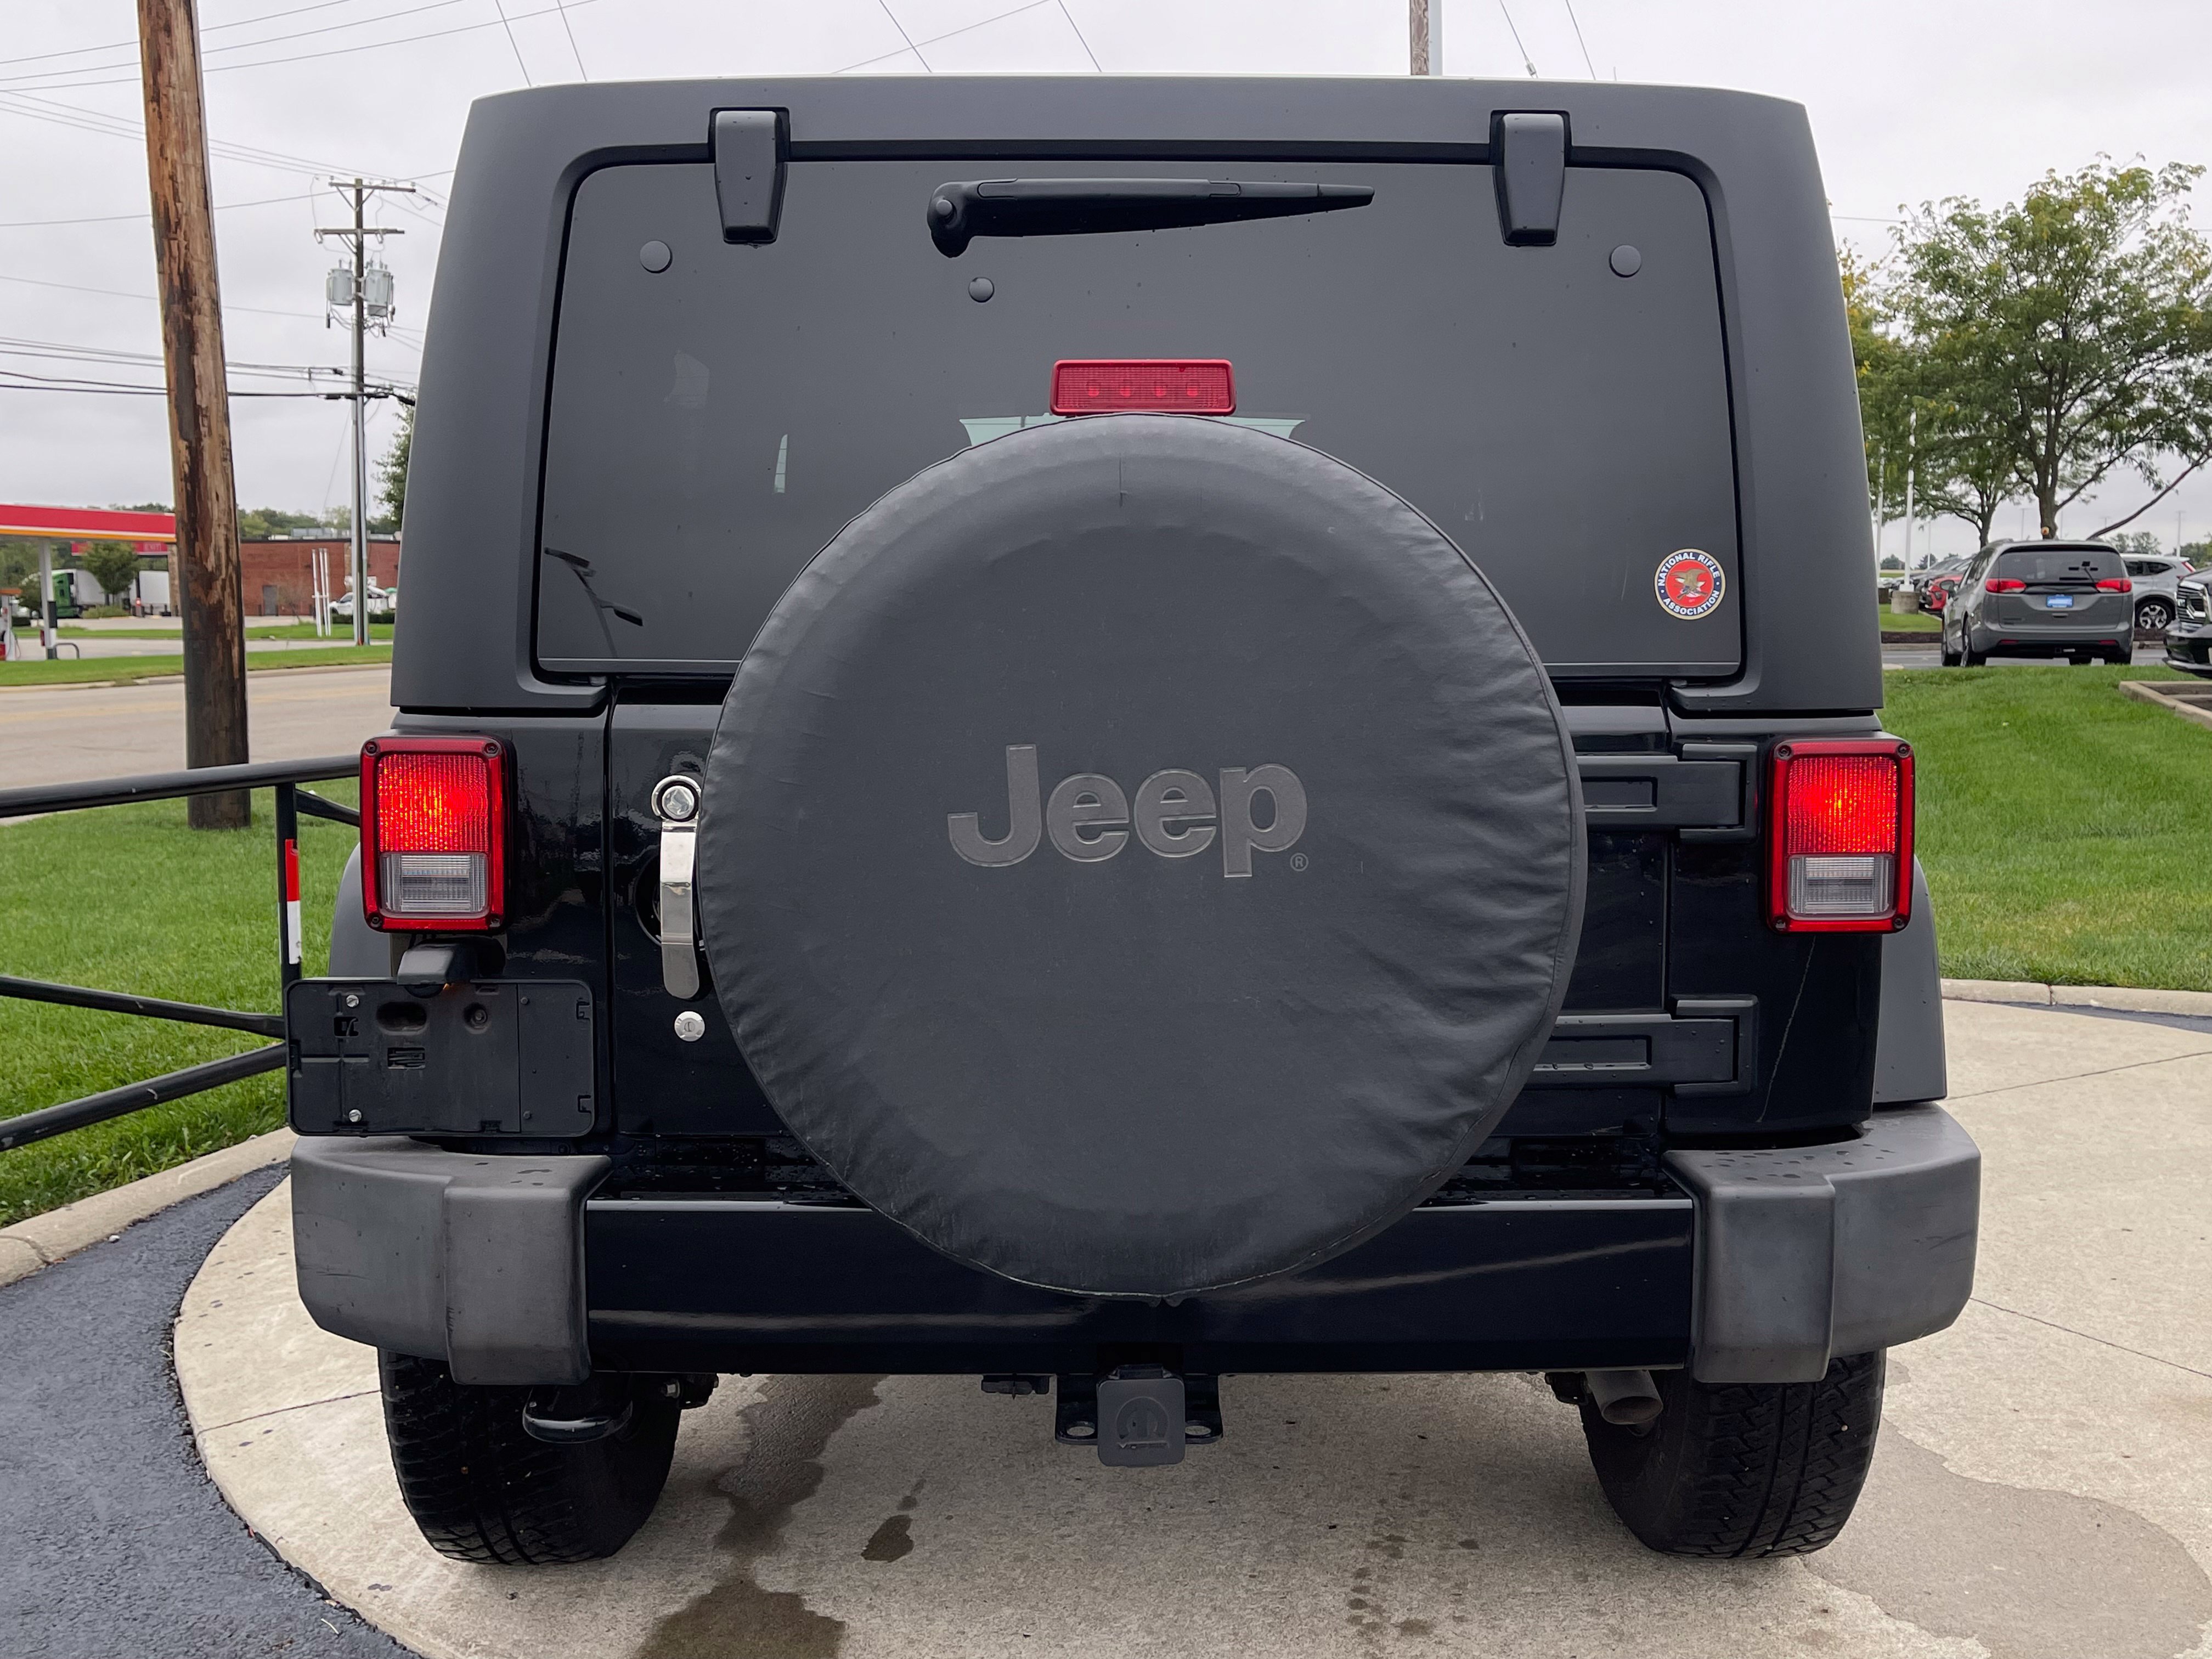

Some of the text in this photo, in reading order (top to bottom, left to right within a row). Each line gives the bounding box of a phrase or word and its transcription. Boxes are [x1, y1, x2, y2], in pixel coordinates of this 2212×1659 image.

[1658, 552, 1720, 586] NATIONAL RIFLE
[1663, 590, 1720, 615] ASSOCIATION
[947, 744, 1307, 877] Jeep
